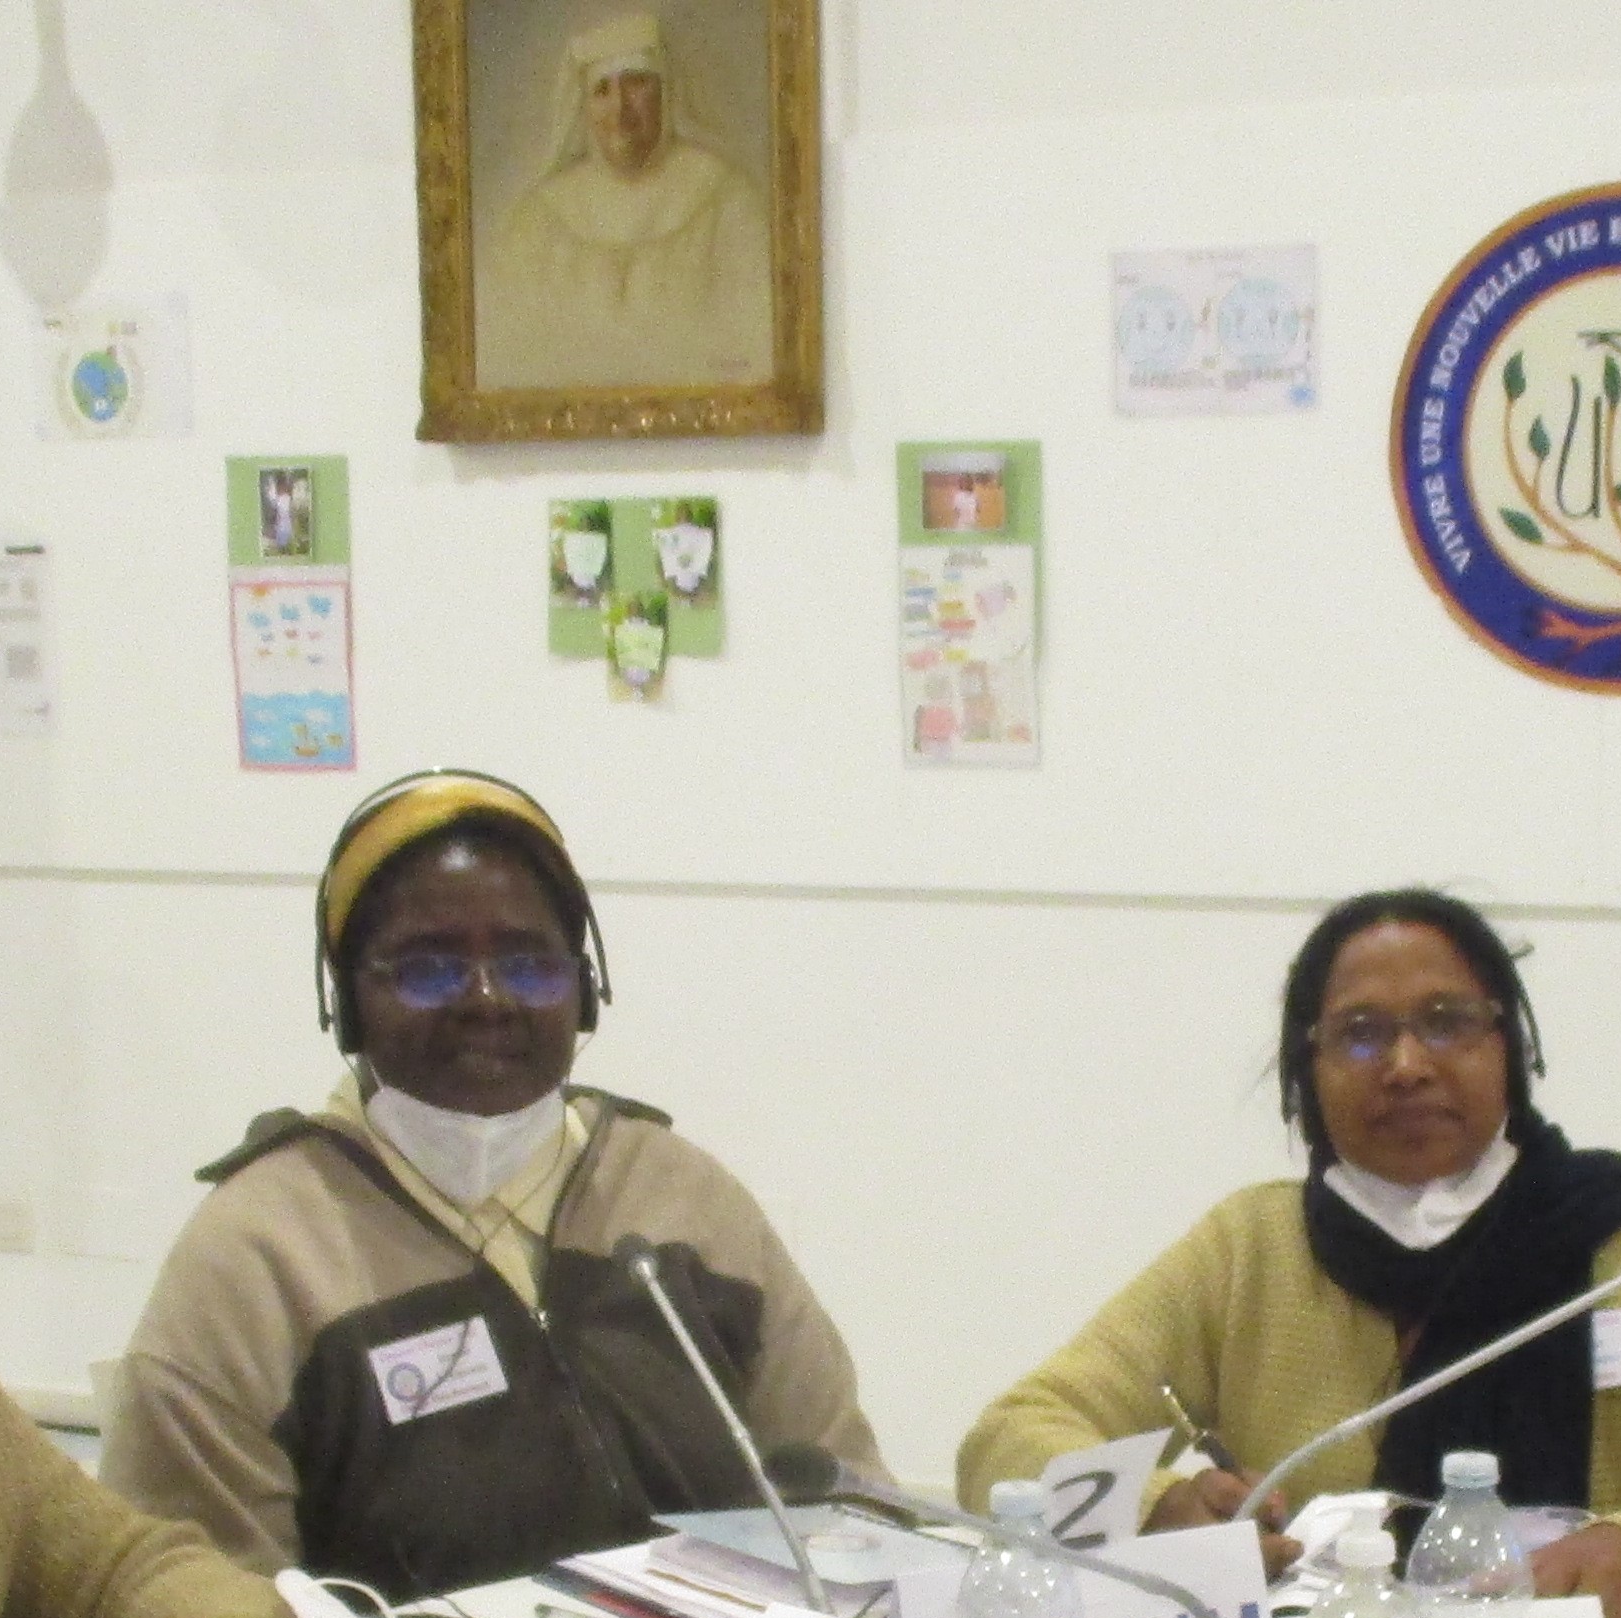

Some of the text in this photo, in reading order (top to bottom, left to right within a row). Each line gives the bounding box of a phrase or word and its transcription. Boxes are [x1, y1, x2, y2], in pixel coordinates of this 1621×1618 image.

[1544, 219, 1600, 257] VIE
[1430, 246, 1542, 391] NOUVELLE
[1419, 397, 1445, 467] UNE
[1050, 1469, 1118, 1551] 2
